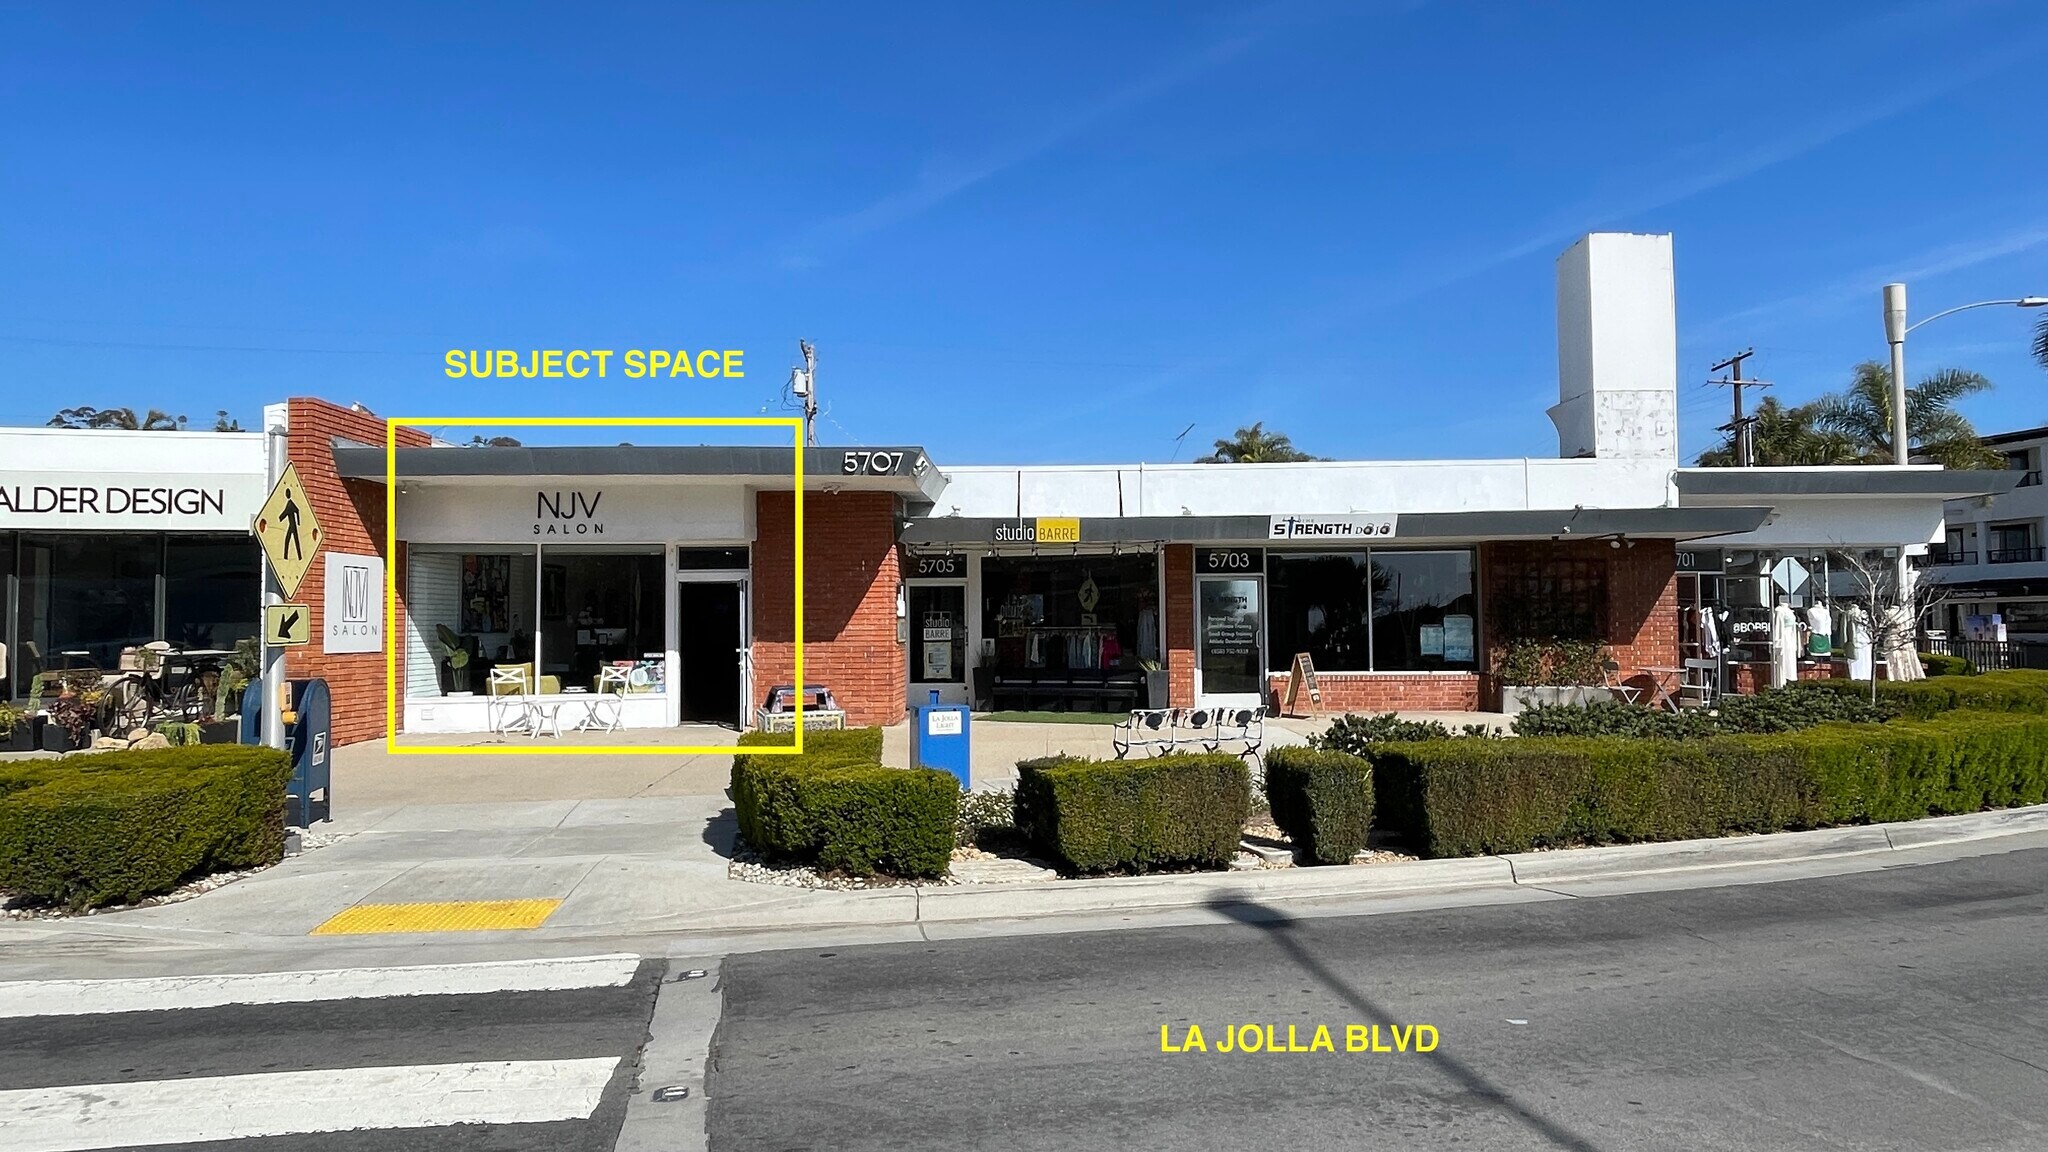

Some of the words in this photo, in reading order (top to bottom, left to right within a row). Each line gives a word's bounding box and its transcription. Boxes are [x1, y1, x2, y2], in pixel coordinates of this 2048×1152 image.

[844, 451, 904, 473] 5707
[106, 487, 224, 515] DESIGN
[537, 491, 602, 519] NJV
[533, 524, 603, 535] SALON
[995, 518, 1035, 541] studio
[1039, 527, 1077, 541] BARRE
[1273, 521, 1352, 537] STRENGTH
[918, 559, 955, 574] 5705
[1208, 552, 1250, 568] 5703
[344, 569, 368, 619] NJV
[925, 611, 950, 628] studio
[332, 625, 378, 637] SALON
[925, 629, 950, 639] BARRE
